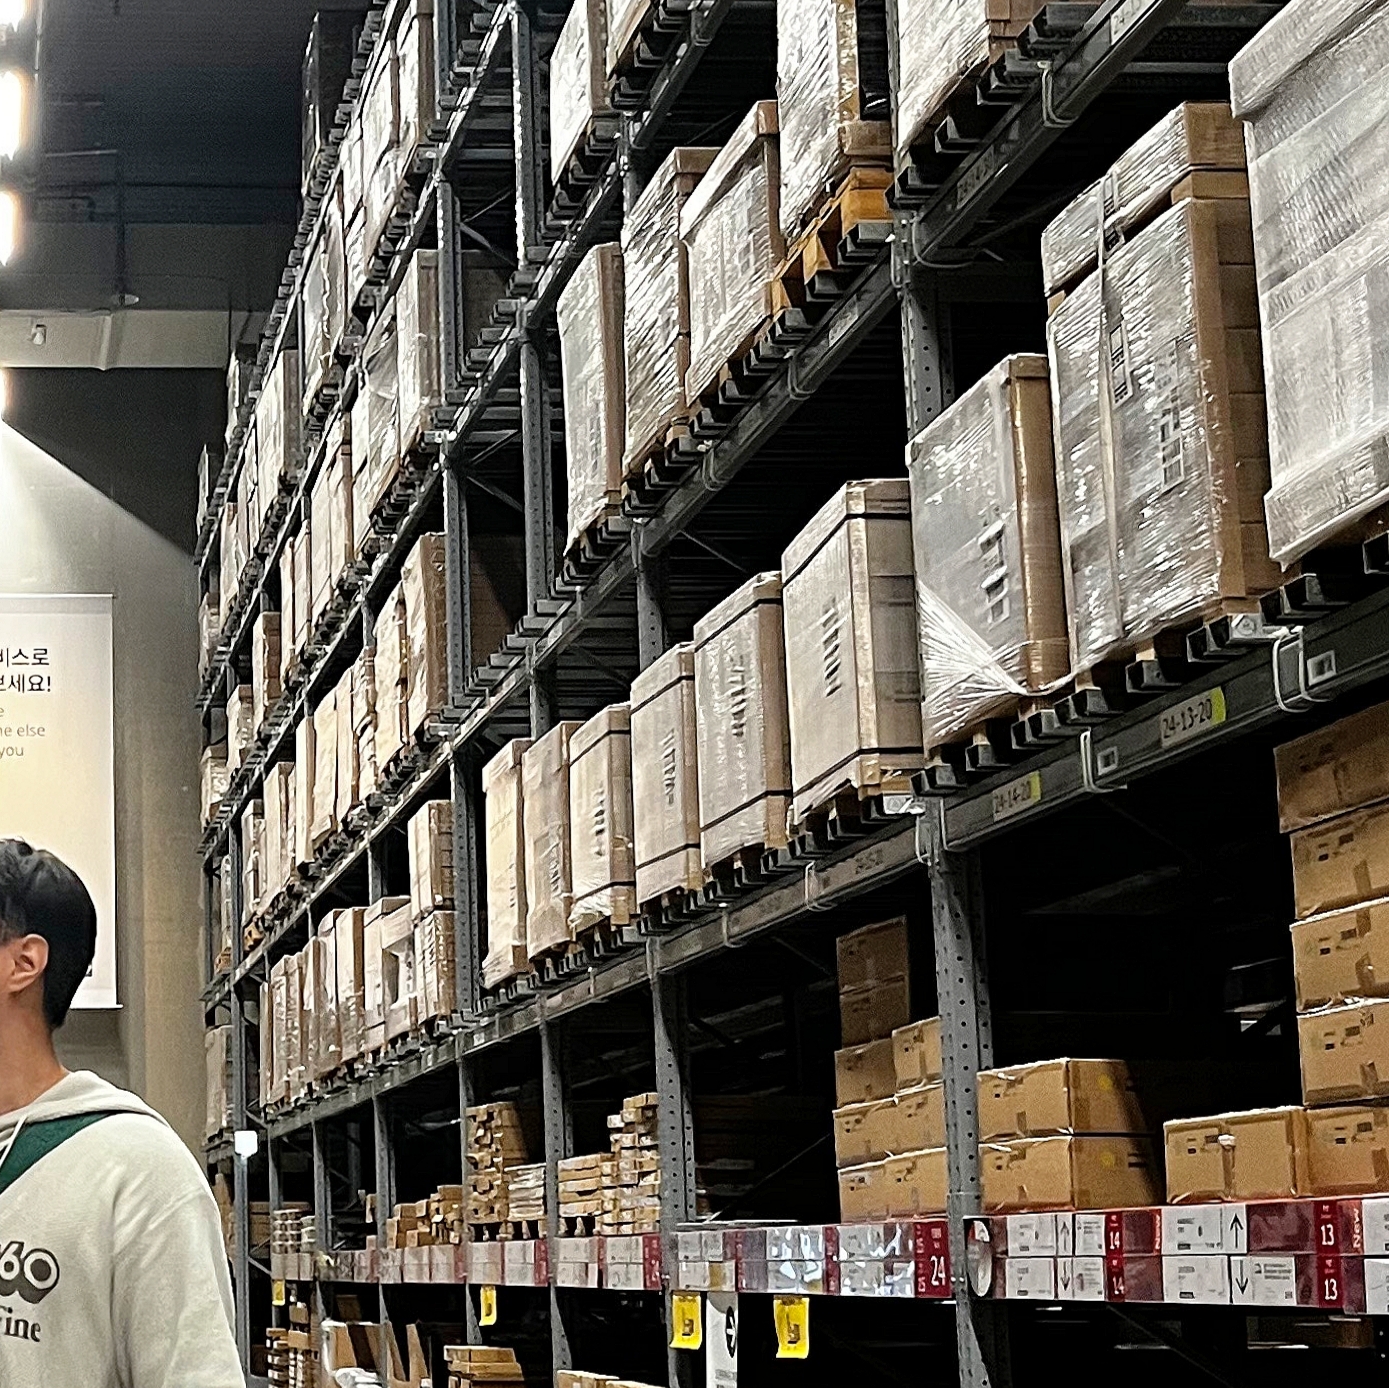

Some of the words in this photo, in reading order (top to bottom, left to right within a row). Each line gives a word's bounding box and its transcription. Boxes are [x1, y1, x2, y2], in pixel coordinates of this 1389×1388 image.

[1162, 698, 1213, 739] 24-13-20
[16, 724, 46, 738] else
[1109, 1230, 1121, 1250] 14
[1320, 1223, 1335, 1247] 13
[930, 1255, 946, 1287] 24
[1323, 1278, 1339, 1301] 13
